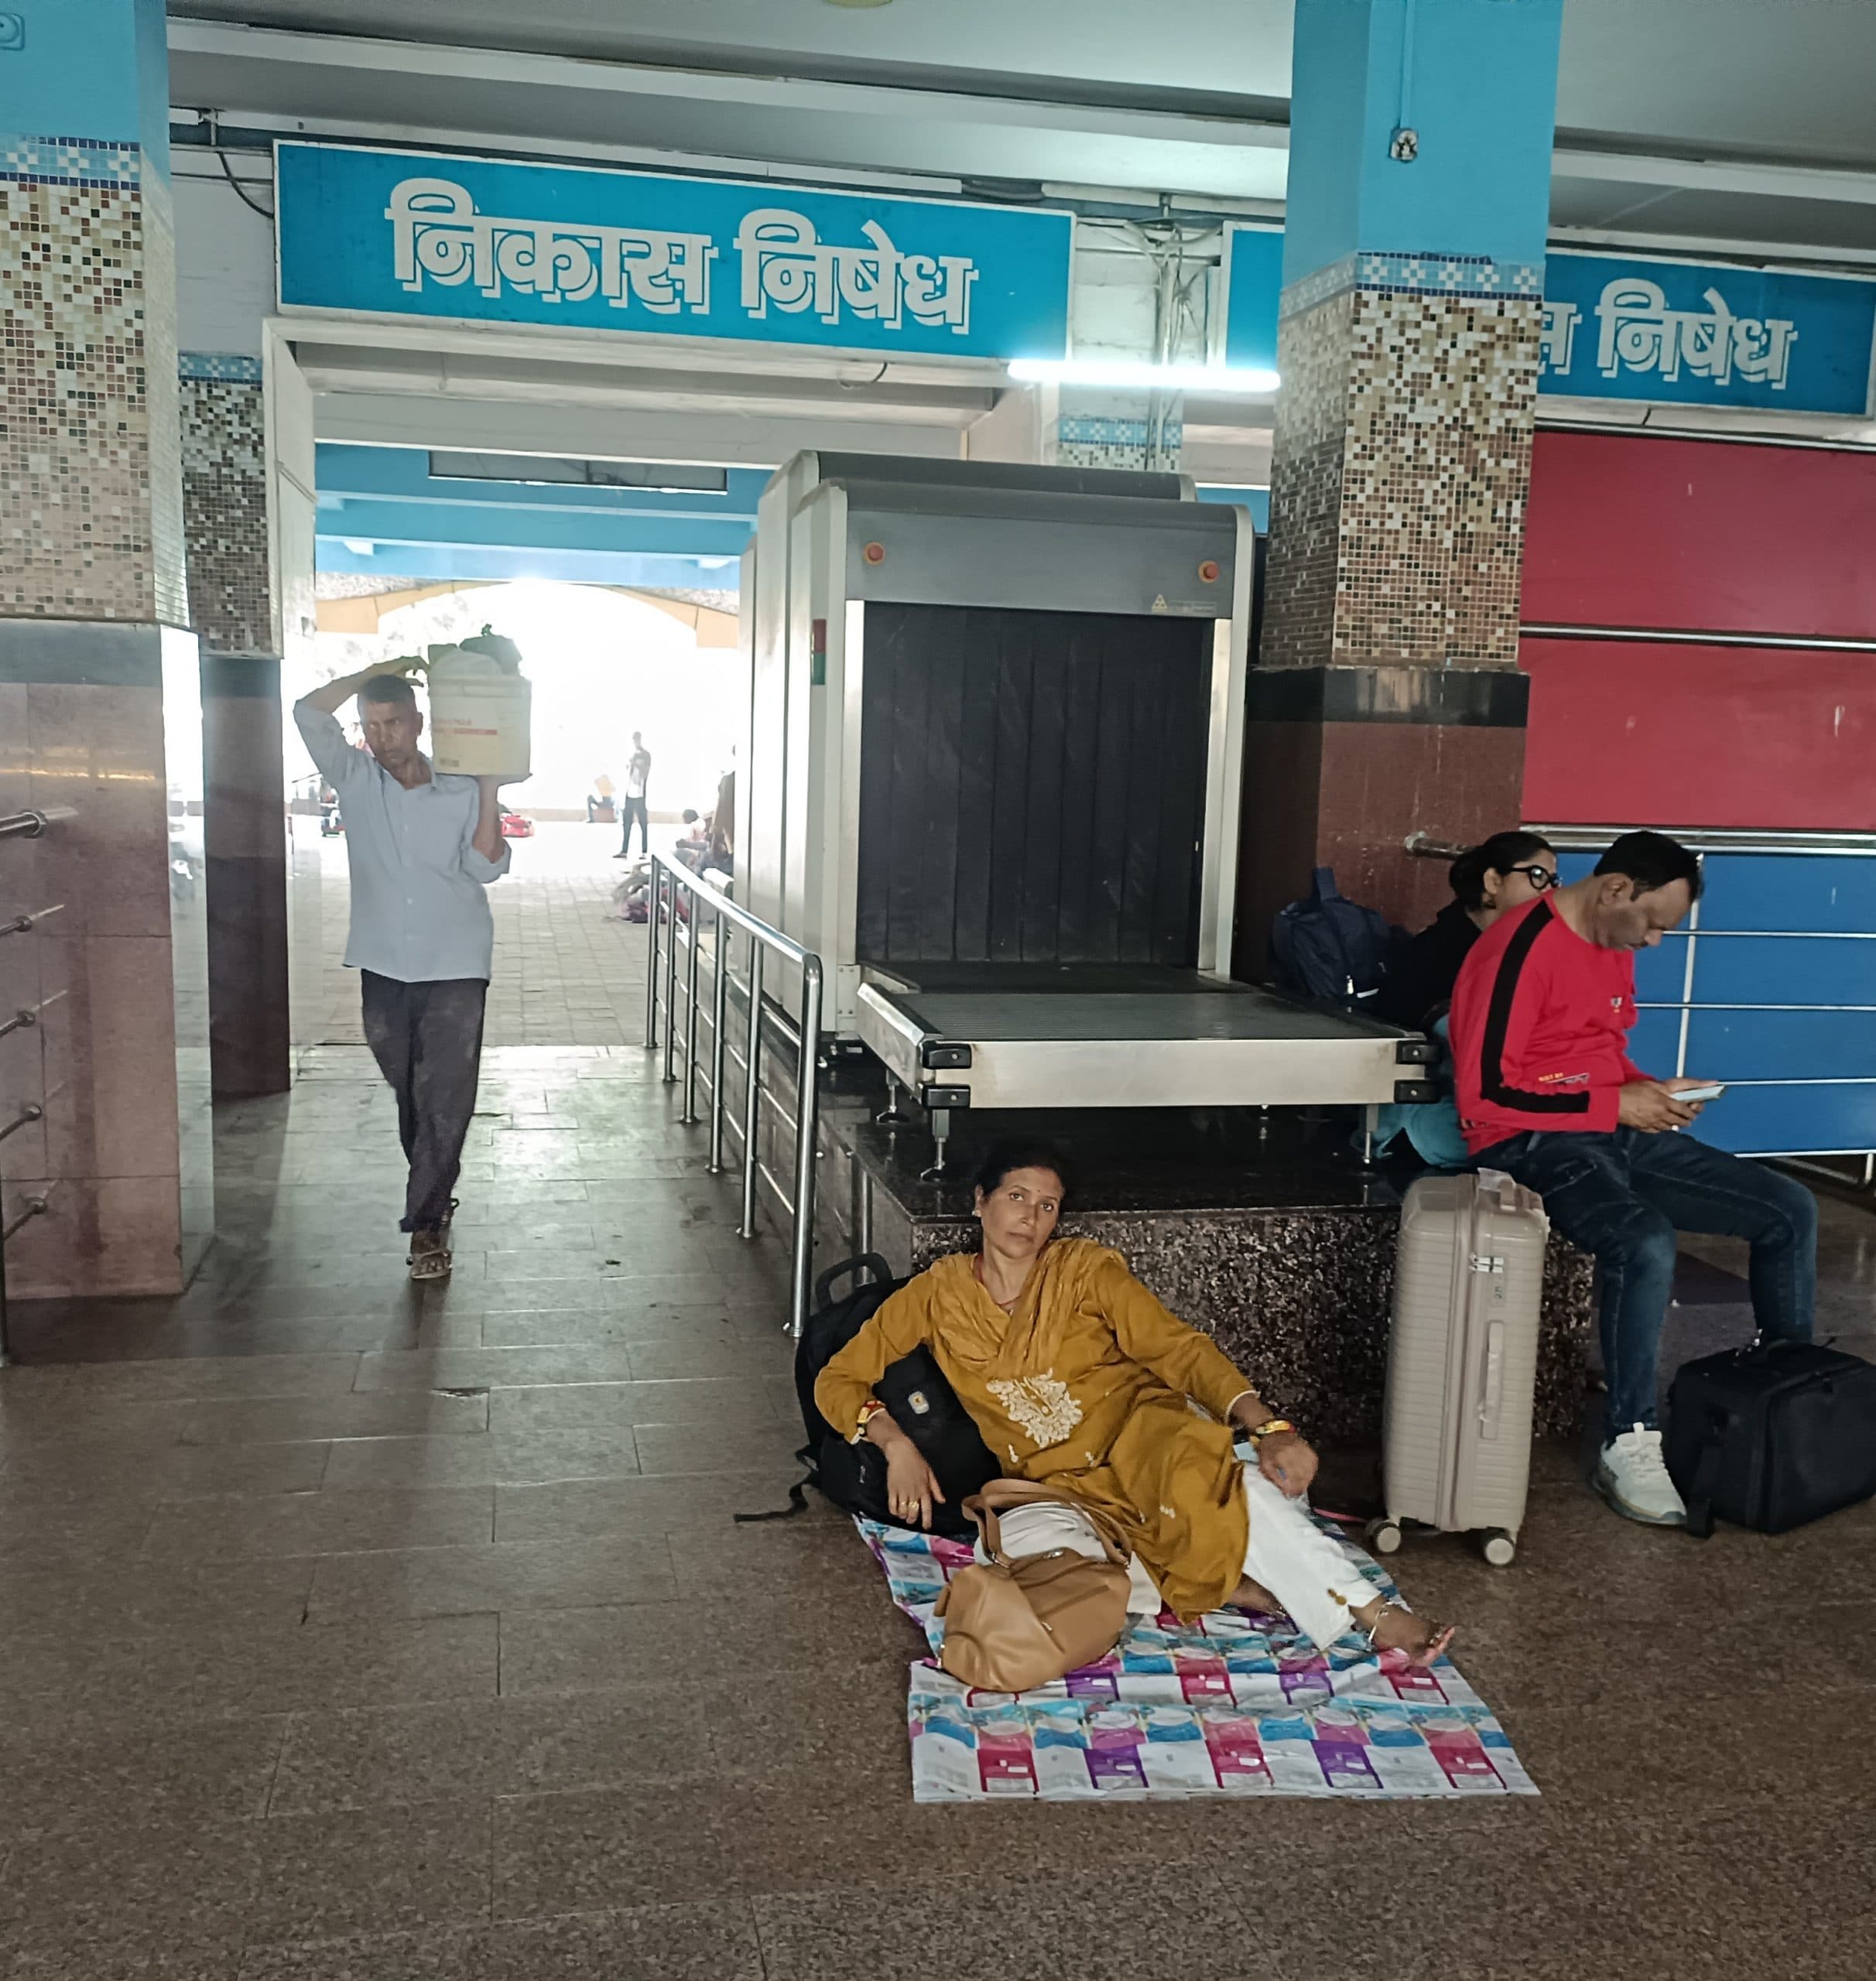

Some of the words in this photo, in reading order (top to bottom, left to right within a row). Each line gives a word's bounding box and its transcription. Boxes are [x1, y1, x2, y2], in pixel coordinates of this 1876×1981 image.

[385, 177, 718, 315] निकास
[733, 208, 979, 334] निषेध
[1594, 278, 1799, 390] निषेध
